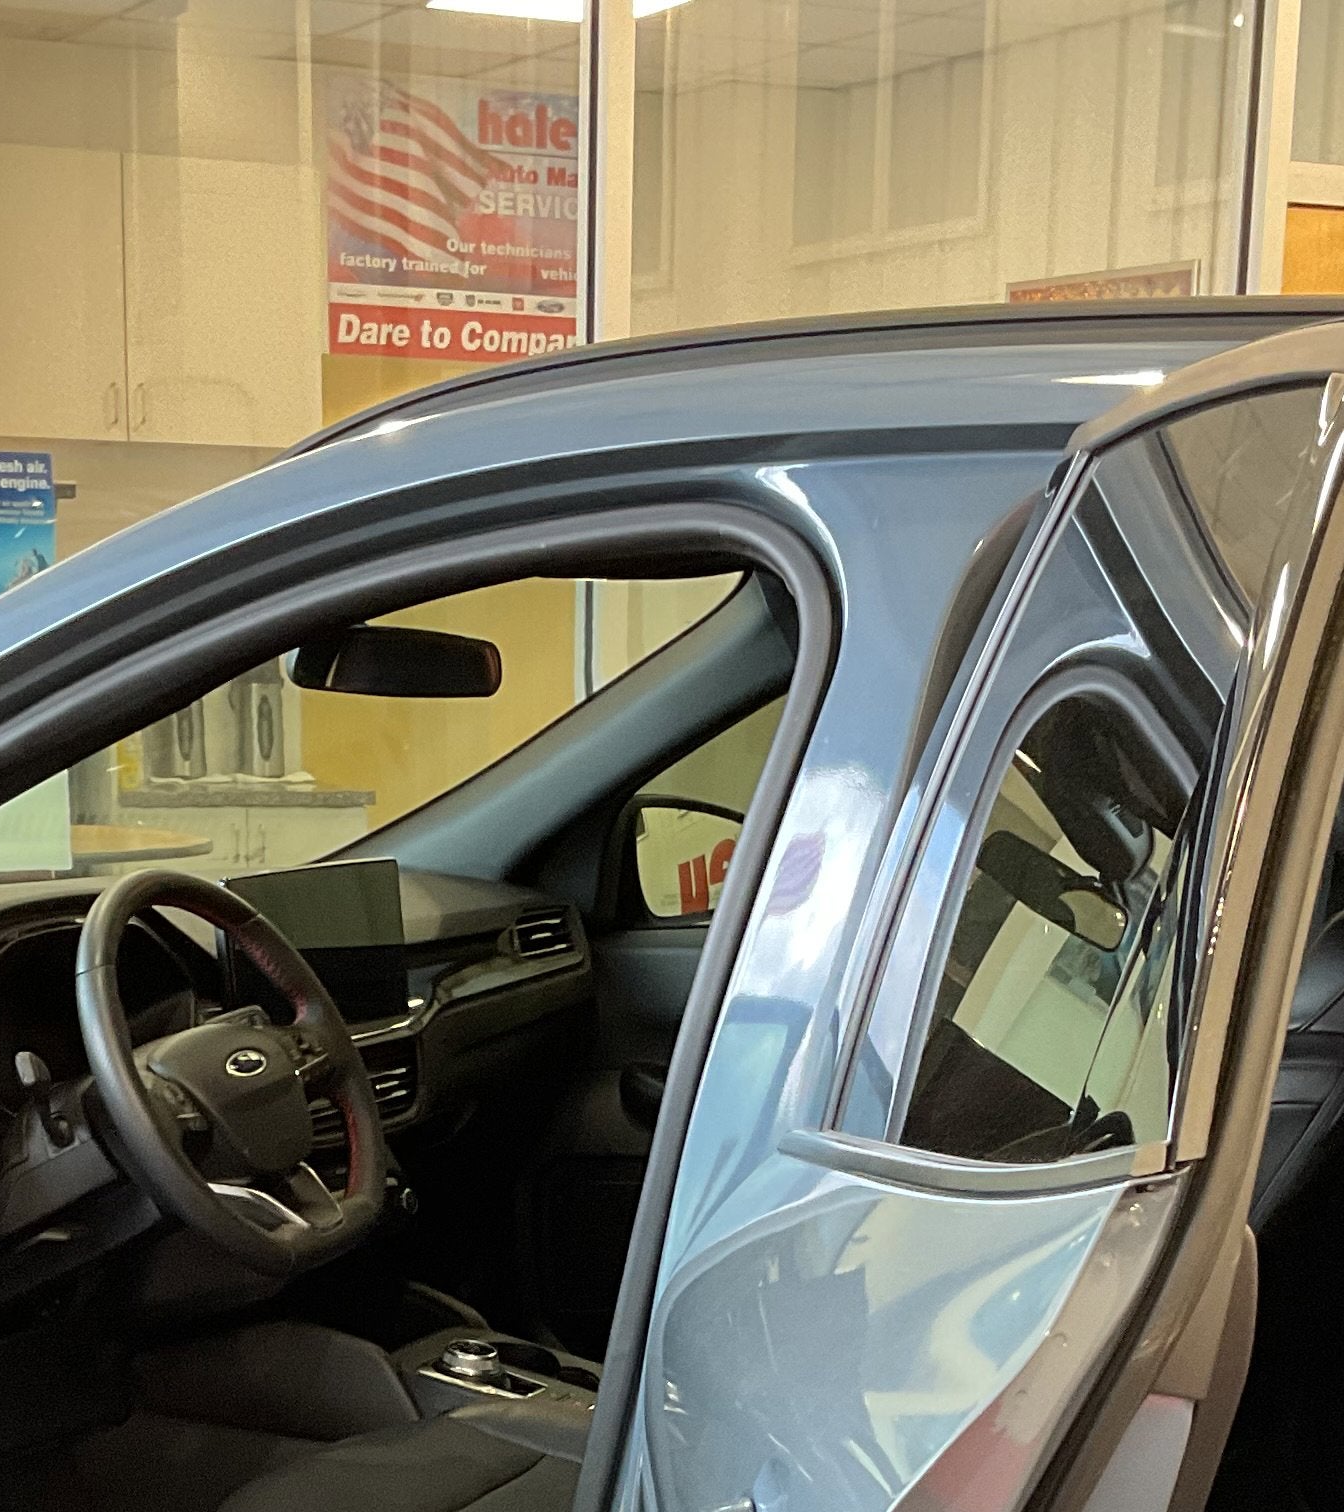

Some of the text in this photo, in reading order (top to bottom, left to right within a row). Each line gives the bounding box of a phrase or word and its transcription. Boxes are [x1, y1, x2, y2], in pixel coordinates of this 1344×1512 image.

[478, 98, 577, 151] hale
[446, 239, 572, 260] Our technicians
[340, 252, 397, 272] factory
[402, 256, 458, 273] trained
[464, 261, 487, 277] for
[338, 313, 411, 346] Dare
[421, 320, 452, 349] to
[27, 461, 48, 474] air.
[0, 478, 50, 491] engine.
